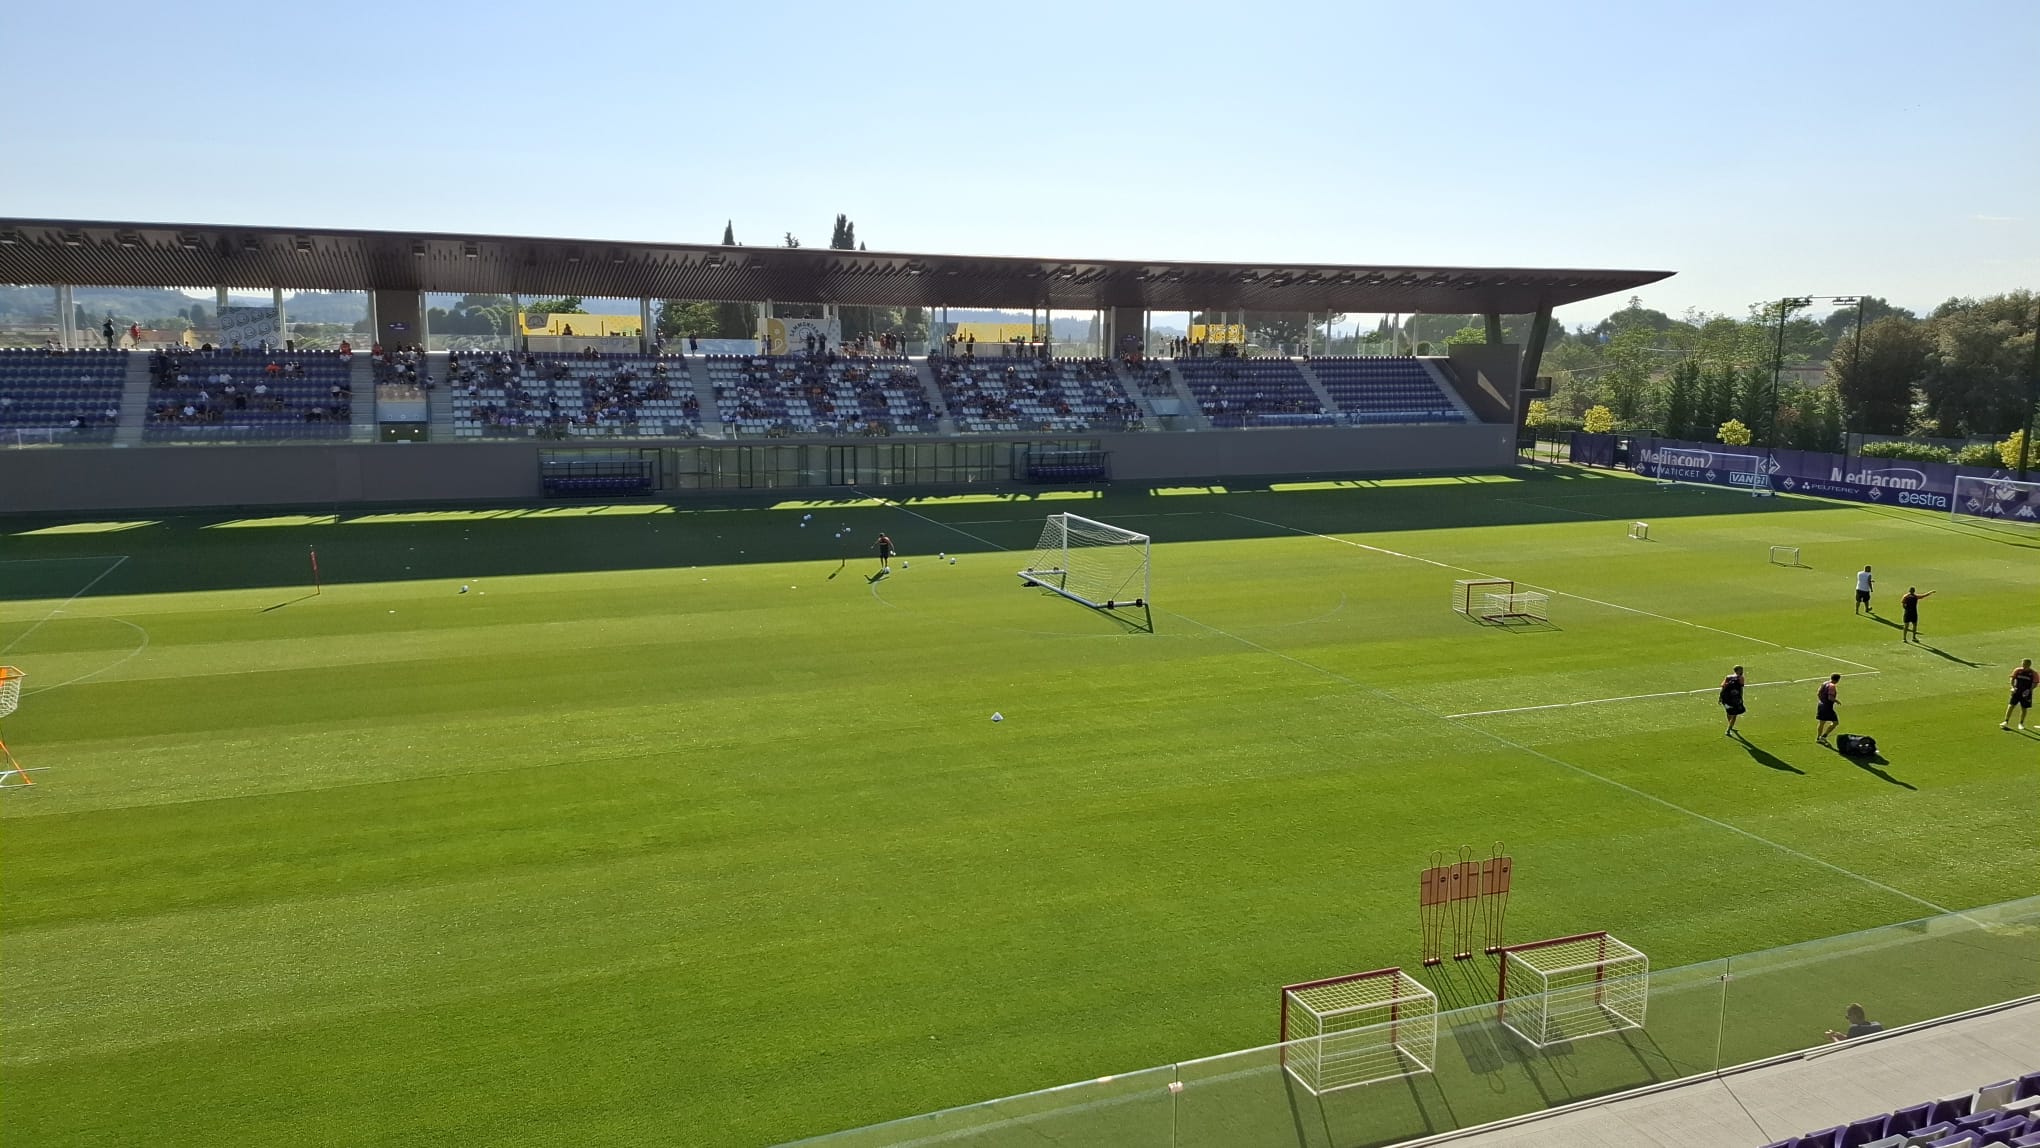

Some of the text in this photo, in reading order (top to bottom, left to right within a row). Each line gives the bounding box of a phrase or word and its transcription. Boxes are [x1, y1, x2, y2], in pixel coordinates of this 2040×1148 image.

[1640, 449, 1705, 468] Mediacom
[1651, 465, 1700, 478] VVATICKET
[1909, 491, 1947, 508] estra
